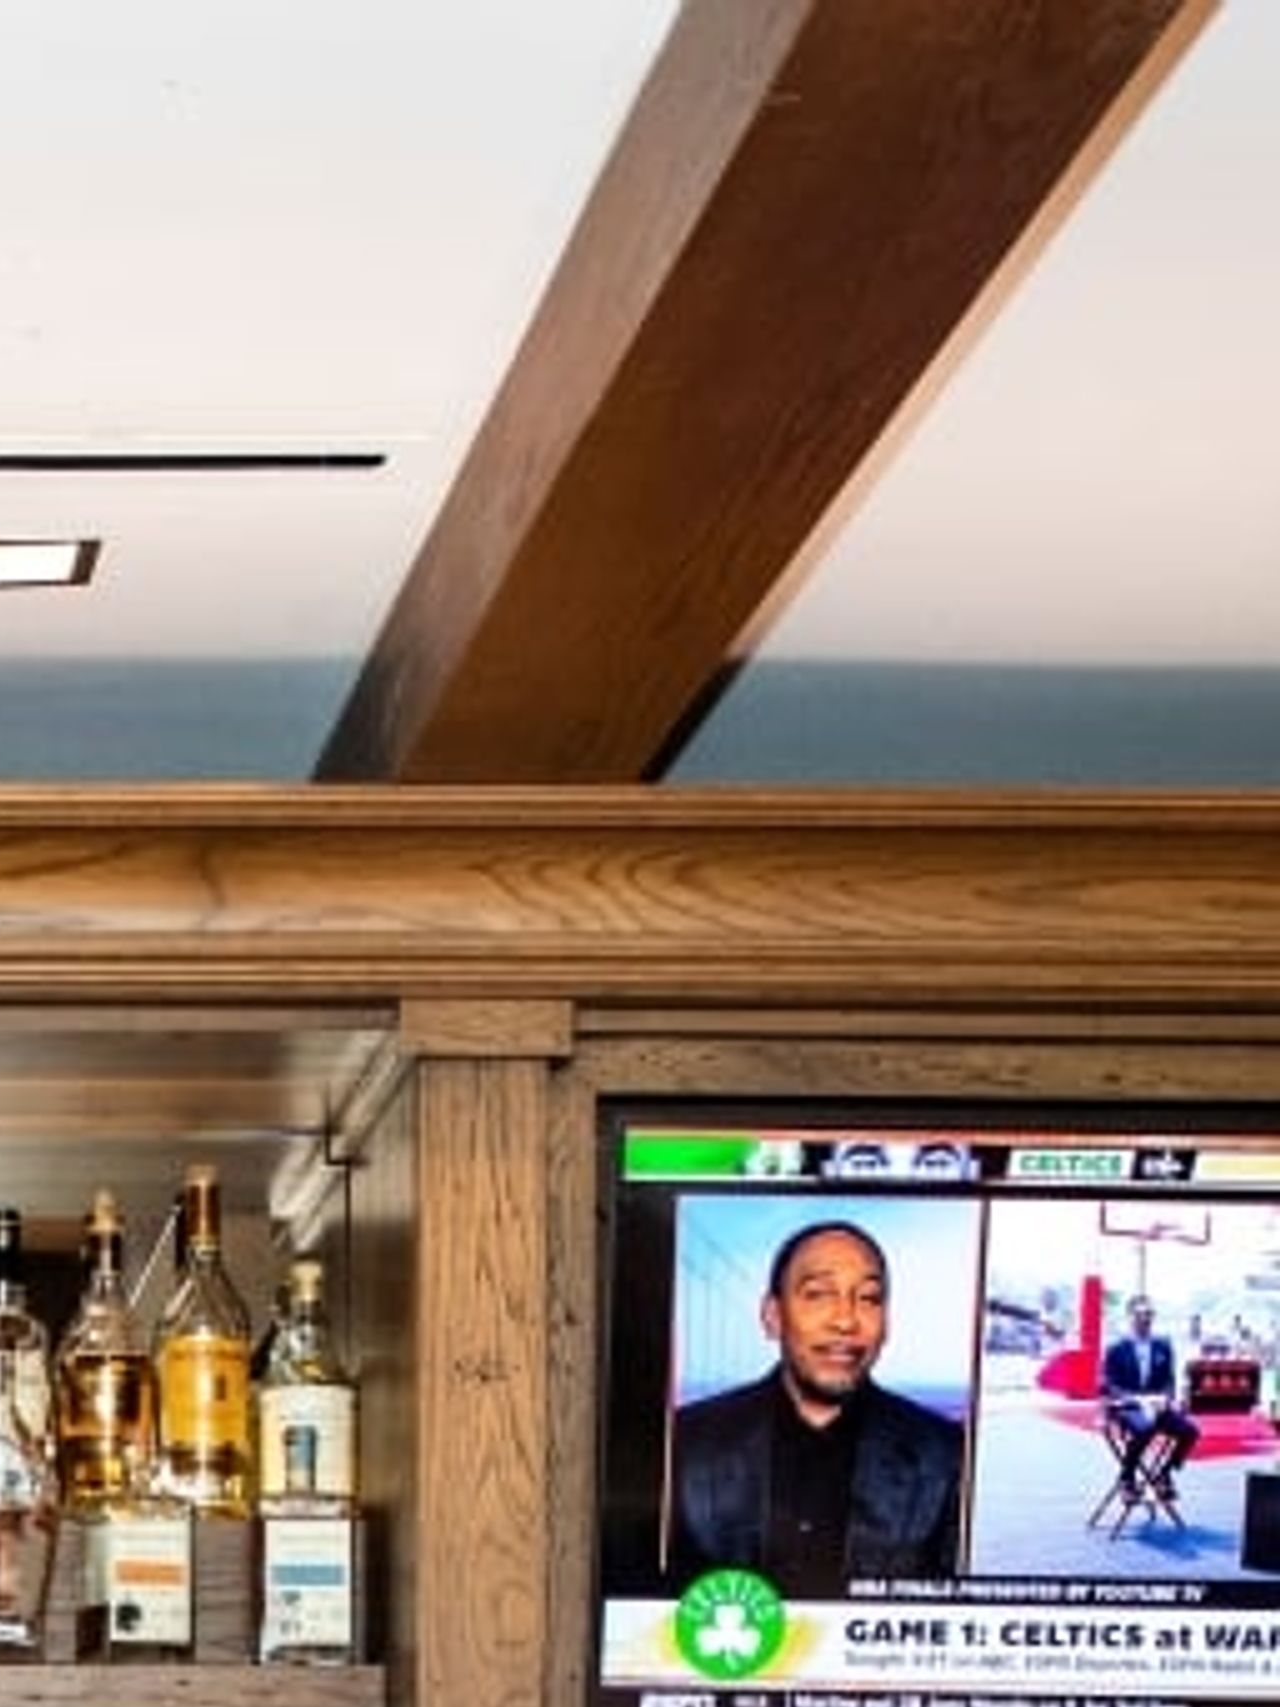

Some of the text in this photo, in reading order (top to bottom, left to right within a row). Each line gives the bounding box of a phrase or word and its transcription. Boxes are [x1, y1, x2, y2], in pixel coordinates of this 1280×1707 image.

[1017, 1155, 1123, 1172] CELTICS
[845, 1618, 949, 1647] GAME
[961, 1622, 988, 1648] 1:
[999, 1621, 1144, 1649] CELTICS
[1154, 1625, 1192, 1650] at
